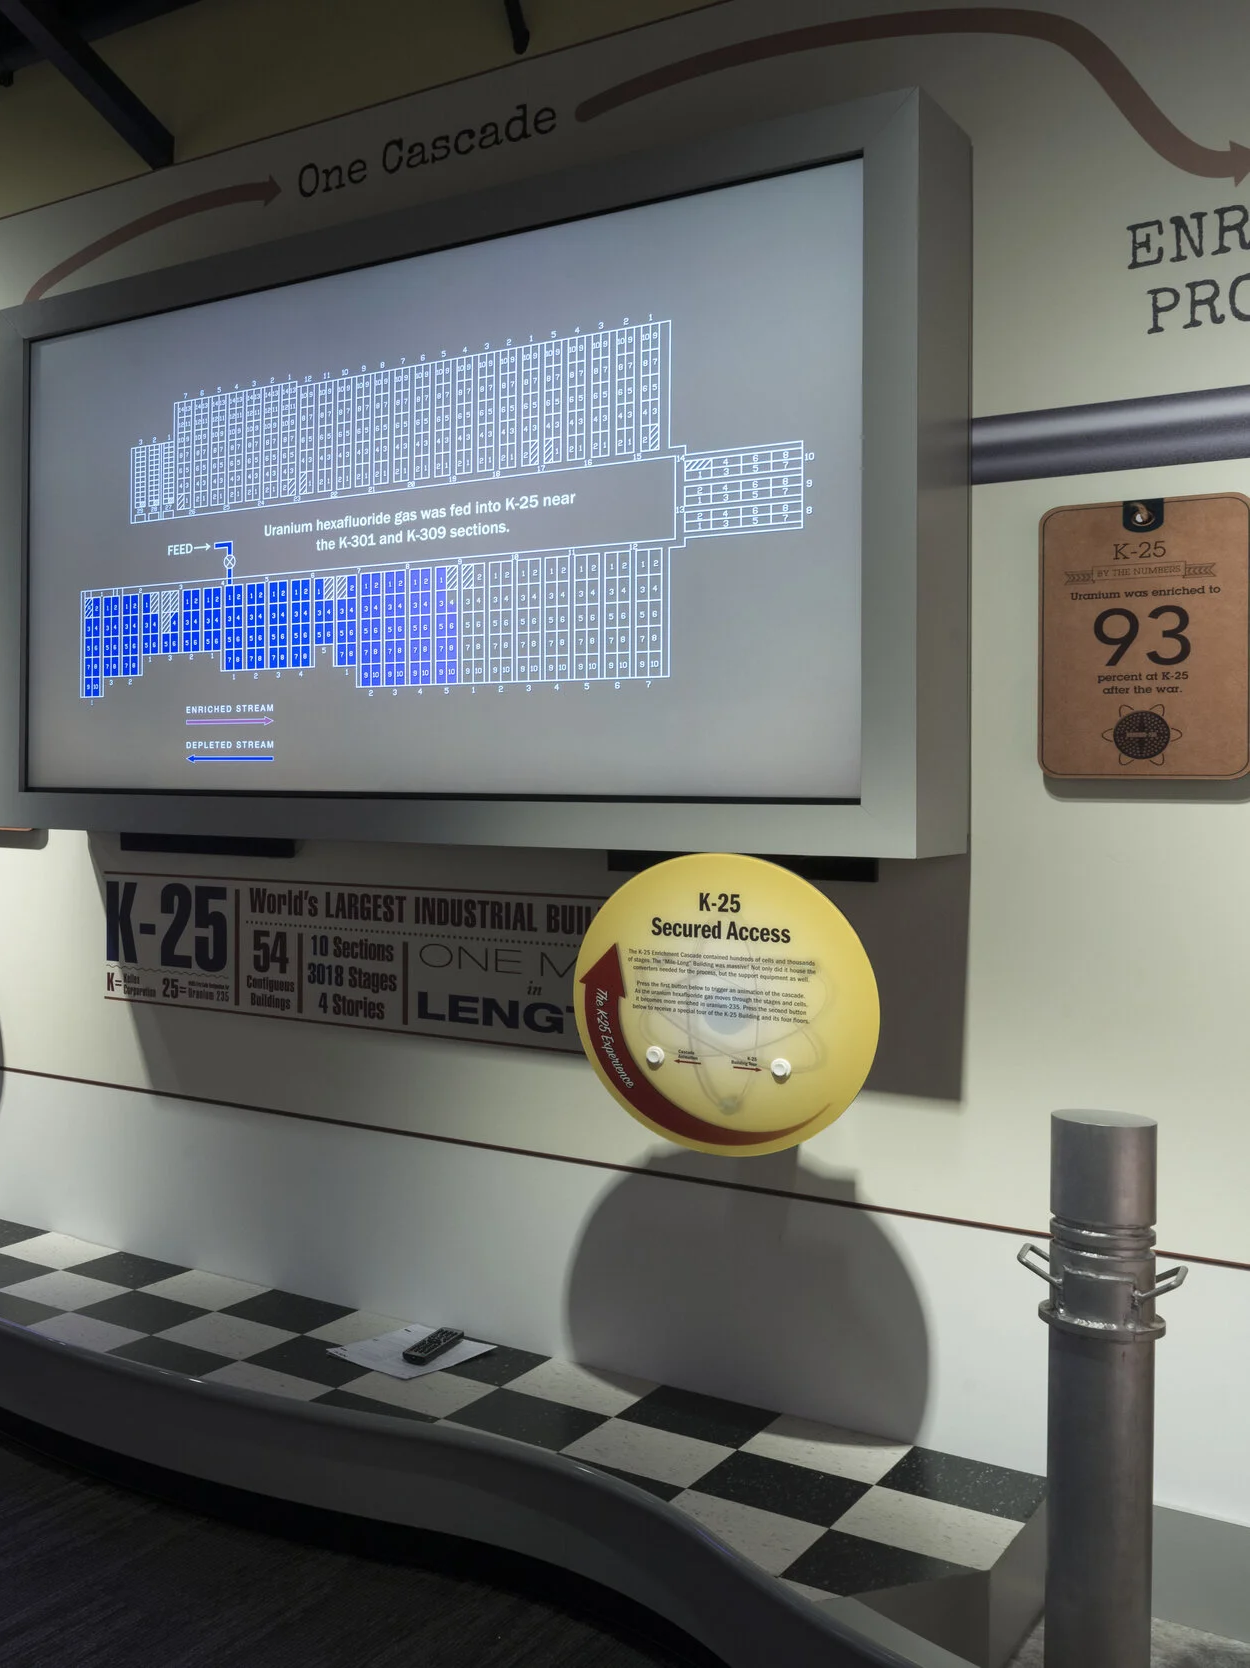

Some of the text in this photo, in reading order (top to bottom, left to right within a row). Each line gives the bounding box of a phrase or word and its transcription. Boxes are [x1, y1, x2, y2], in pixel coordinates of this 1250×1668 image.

[298, 104, 556, 198] One Cascade
[264, 492, 576, 536] Uranium hexafluoride gas was fed into K-25 near
[316, 522, 510, 551] the K-301 and K-309 sections.
[168, 544, 193, 556] FEED
[1112, 540, 1166, 561] K-25
[1112, 568, 1132, 577] THE
[1134, 564, 1181, 576] NUMBERS
[1070, 585, 1221, 601] Uranium was enriched to
[1094, 605, 1192, 668] 93
[1097, 671, 1189, 684] percent at K-25
[1102, 684, 1182, 695] after the war.
[186, 704, 274, 714] ENRICHED STREAM
[186, 740, 274, 750] DEPLETED STREAM
[698, 892, 741, 913] K-25
[106, 880, 228, 972] K-25
[250, 888, 318, 918] World's
[326, 890, 406, 924] LARGEST
[414, 896, 538, 932] INDUSTRIAL
[651, 917, 791, 944] Secured Access
[253, 930, 289, 974] 54
[311, 934, 328, 957] 10
[332, 936, 394, 962] Sections
[420, 943, 522, 975] ONE
[246, 974, 295, 994] Contiguous
[307, 962, 543, 996] 3018 Stages in
[123, 984, 230, 1002] Corporation Uranium 235
[250, 992, 292, 1011] Buildings
[318, 992, 328, 1014] 4
[332, 993, 385, 1020] Stories
[596, 988, 634, 1089] The K-25 Experience
